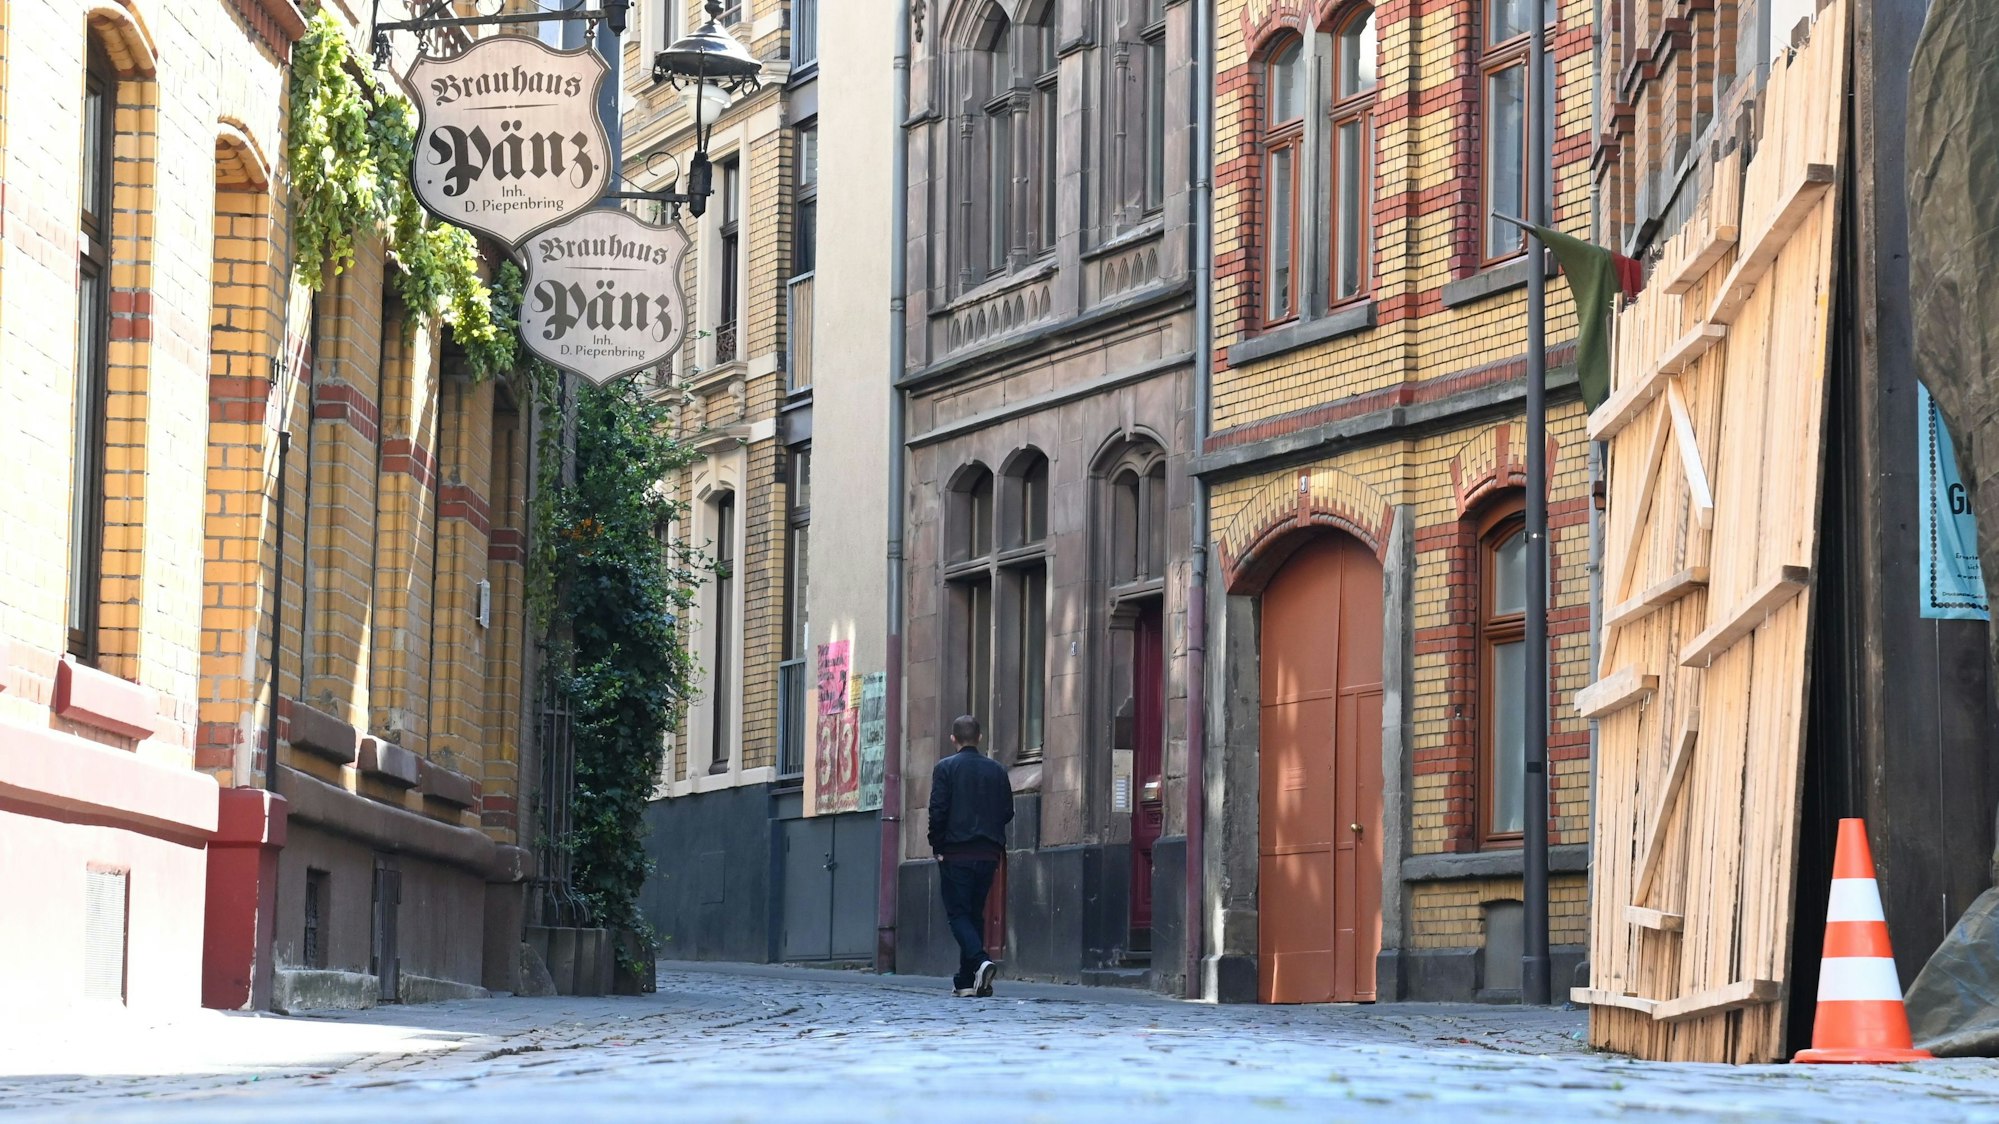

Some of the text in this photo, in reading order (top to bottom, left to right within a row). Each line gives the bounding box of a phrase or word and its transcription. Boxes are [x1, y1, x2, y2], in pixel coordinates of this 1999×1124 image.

[431, 65, 582, 106] Brauhaus
[427, 120, 593, 196] Pänz
[502, 184, 526, 197] Inh.
[465, 198, 564, 214] D. Piepenbring
[539, 234, 669, 265] Brauhaus
[531, 279, 673, 343] Pänz
[593, 335, 613, 345] Inh.
[560, 345, 645, 360] D. Piepenbring
